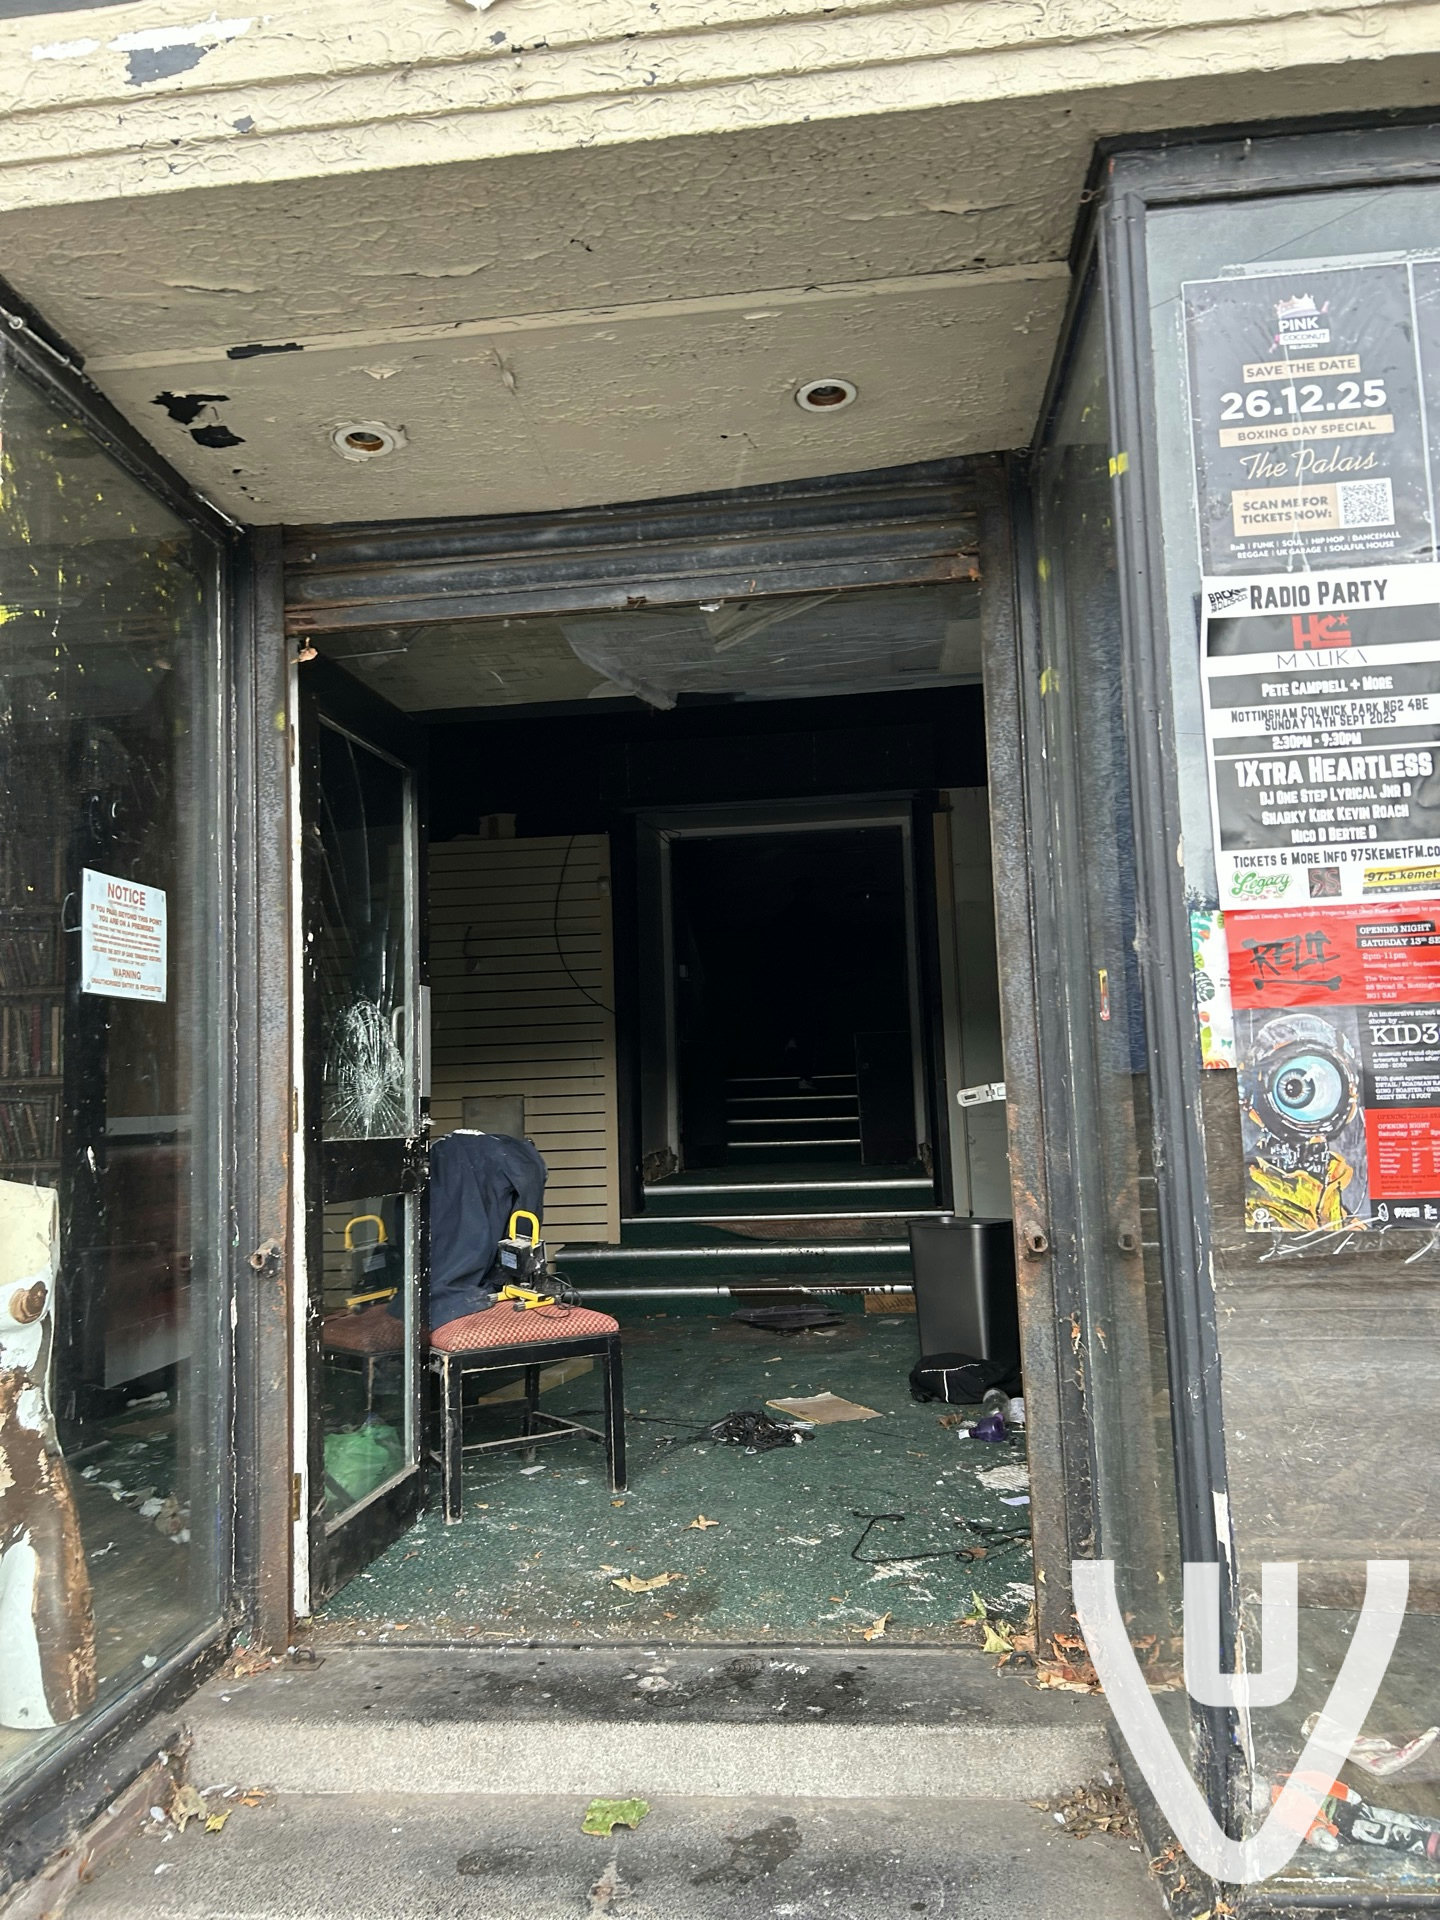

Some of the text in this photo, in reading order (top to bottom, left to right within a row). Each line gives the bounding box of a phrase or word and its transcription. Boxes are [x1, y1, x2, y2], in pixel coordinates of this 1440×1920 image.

[1279, 317, 1319, 332] PINK
[1282, 332, 1327, 341] COCONUT
[1246, 358, 1356, 378] SAVE THE DATE
[1220, 379, 1387, 420] 26.12.25
[1237, 421, 1376, 441] BOXING DAY SPECIAL
[1240, 446, 1378, 480] The Palais
[1243, 496, 1328, 512] SCAN ME FOR
[1241, 509, 1332, 525] TICKETS NOW:
[1237, 540, 1394, 559] REGGAE UK GARAGE SOULFUL HOUSE
[1253, 541, 1274, 549] FUNK
[1282, 539, 1303, 547] SOUL
[1352, 531, 1401, 542] DANCEHALL
[1250, 585, 1310, 610] RADIO
[1317, 579, 1388, 605] PARTY
[1262, 676, 1393, 697] PETE CAMPBELL + MORE
[1231, 698, 1429, 723] NOTTINGHAM COLWICK PARK NG2 4BE
[1265, 711, 1396, 731] SUNDAY 14TH SEPT 2025
[1234, 752, 1433, 787] 1XTRA HEARTLESS
[1259, 791, 1274, 806] DJ
[1276, 790, 1299, 804] ONE
[1300, 789, 1328, 803] STEP
[1330, 786, 1377, 801] LYRICAL
[1261, 804, 1410, 826] SHARKY KIRK KEVIN ROACH
[1291, 828, 1316, 844] NICO
[1328, 826, 1366, 841] BERTIE
[1233, 854, 1277, 868] TICKETS
[1280, 853, 1288, 865] &
[1291, 851, 1320, 865] MORE
[1323, 850, 1347, 863] INFO
[1231, 872, 1290, 896] Legacy
[1367, 869, 1437, 881] 97.5 kemet
[107, 882, 146, 906] NOTICE
[96, 905, 105, 913] YOU
[118, 911, 137, 920] BEYOND
[99, 915, 108, 923] YOU
[1359, 923, 1431, 934] OPENING NIGHT
[1361, 938, 1408, 947] SATURDAY
[112, 967, 141, 980] WARNING
[1369, 1023, 1440, 1045] KID3
